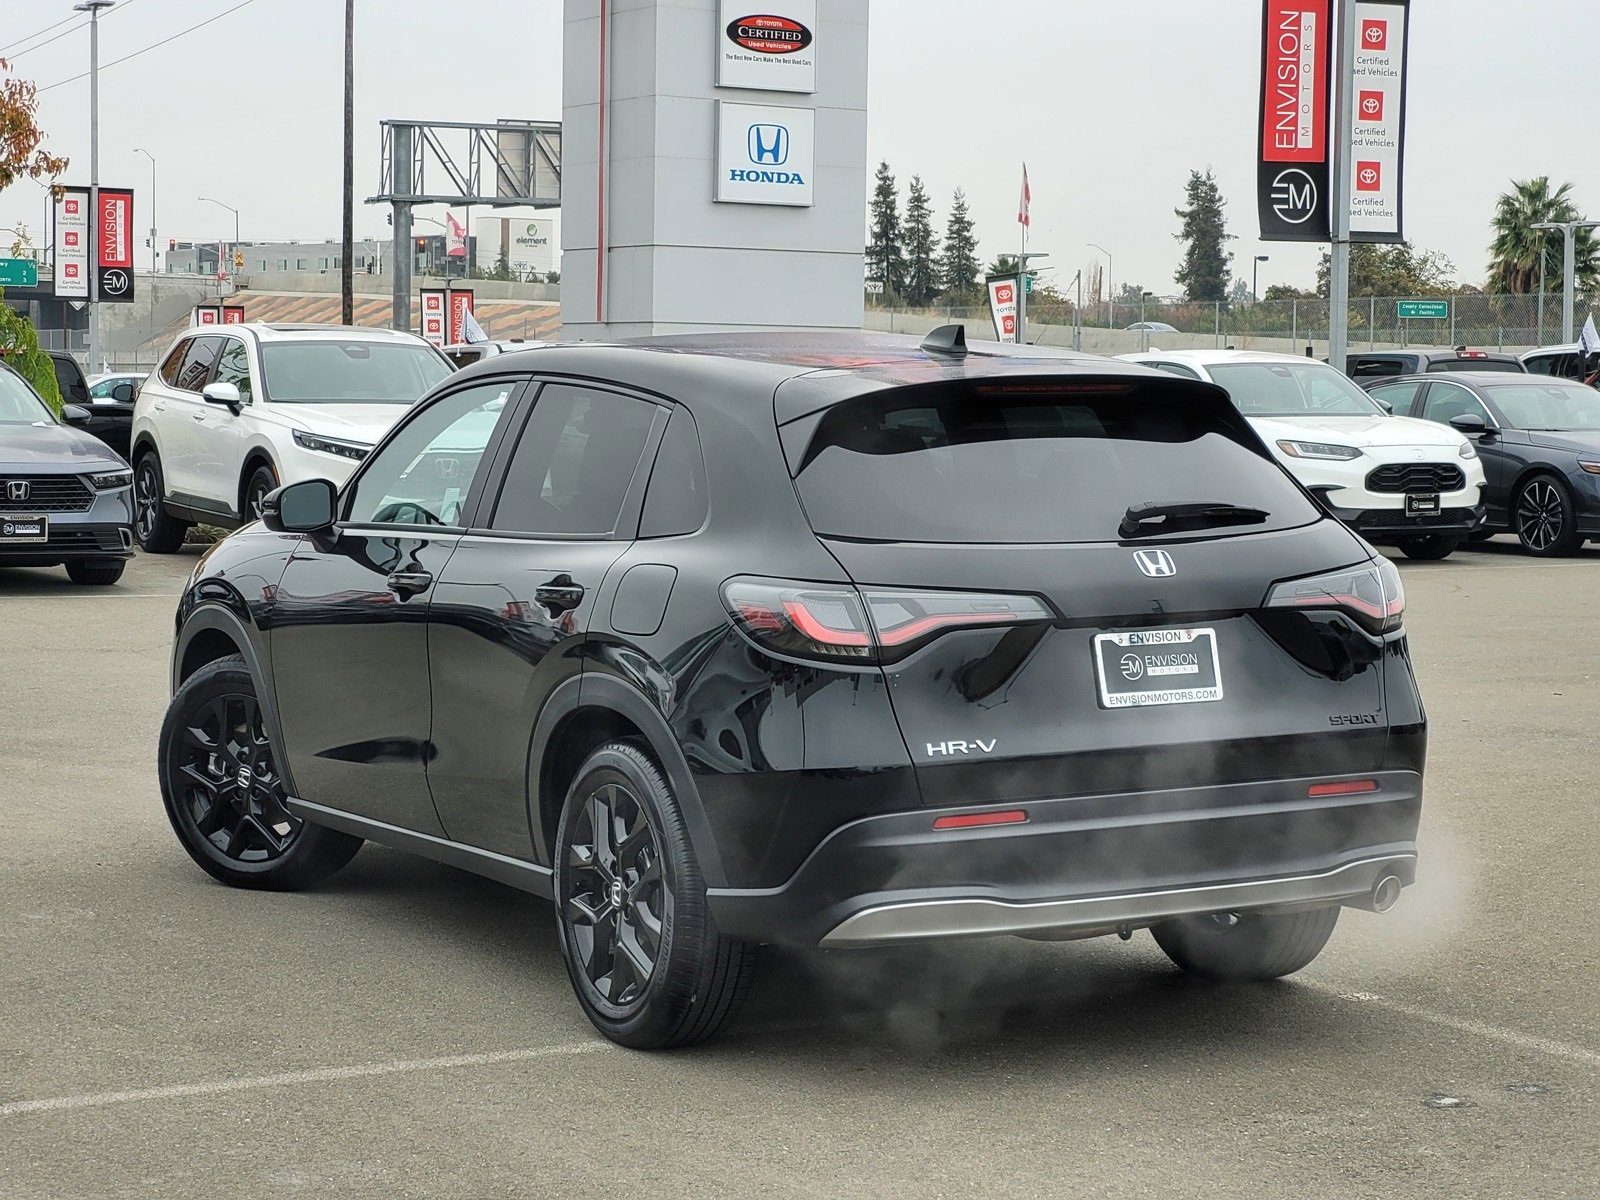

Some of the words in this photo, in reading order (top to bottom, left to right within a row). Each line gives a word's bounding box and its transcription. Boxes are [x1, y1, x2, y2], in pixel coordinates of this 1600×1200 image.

[738, 26, 801, 40] CERTIFIED
[1356, 56, 1389, 66] Certified
[1368, 68, 1398, 77] Vehicles
[1276, 10, 1299, 148] ENVISION
[1301, 25, 1312, 136] MOTORS
[1354, 128, 1386, 136] Certified
[1365, 139, 1395, 147] Vehicles
[730, 170, 805, 185] HONDA
[1352, 198, 1384, 206] Certified
[1363, 209, 1393, 217] Vehicles
[105, 199, 116, 261] ENVISION
[1129, 632, 1181, 644] ENVISION
[1145, 653, 1198, 666] ENVISION
[1110, 690, 1217, 705] ENVISIONMOTORS.COM
[1329, 714, 1379, 726] SPORT
[927, 739, 996, 756] HR-V
